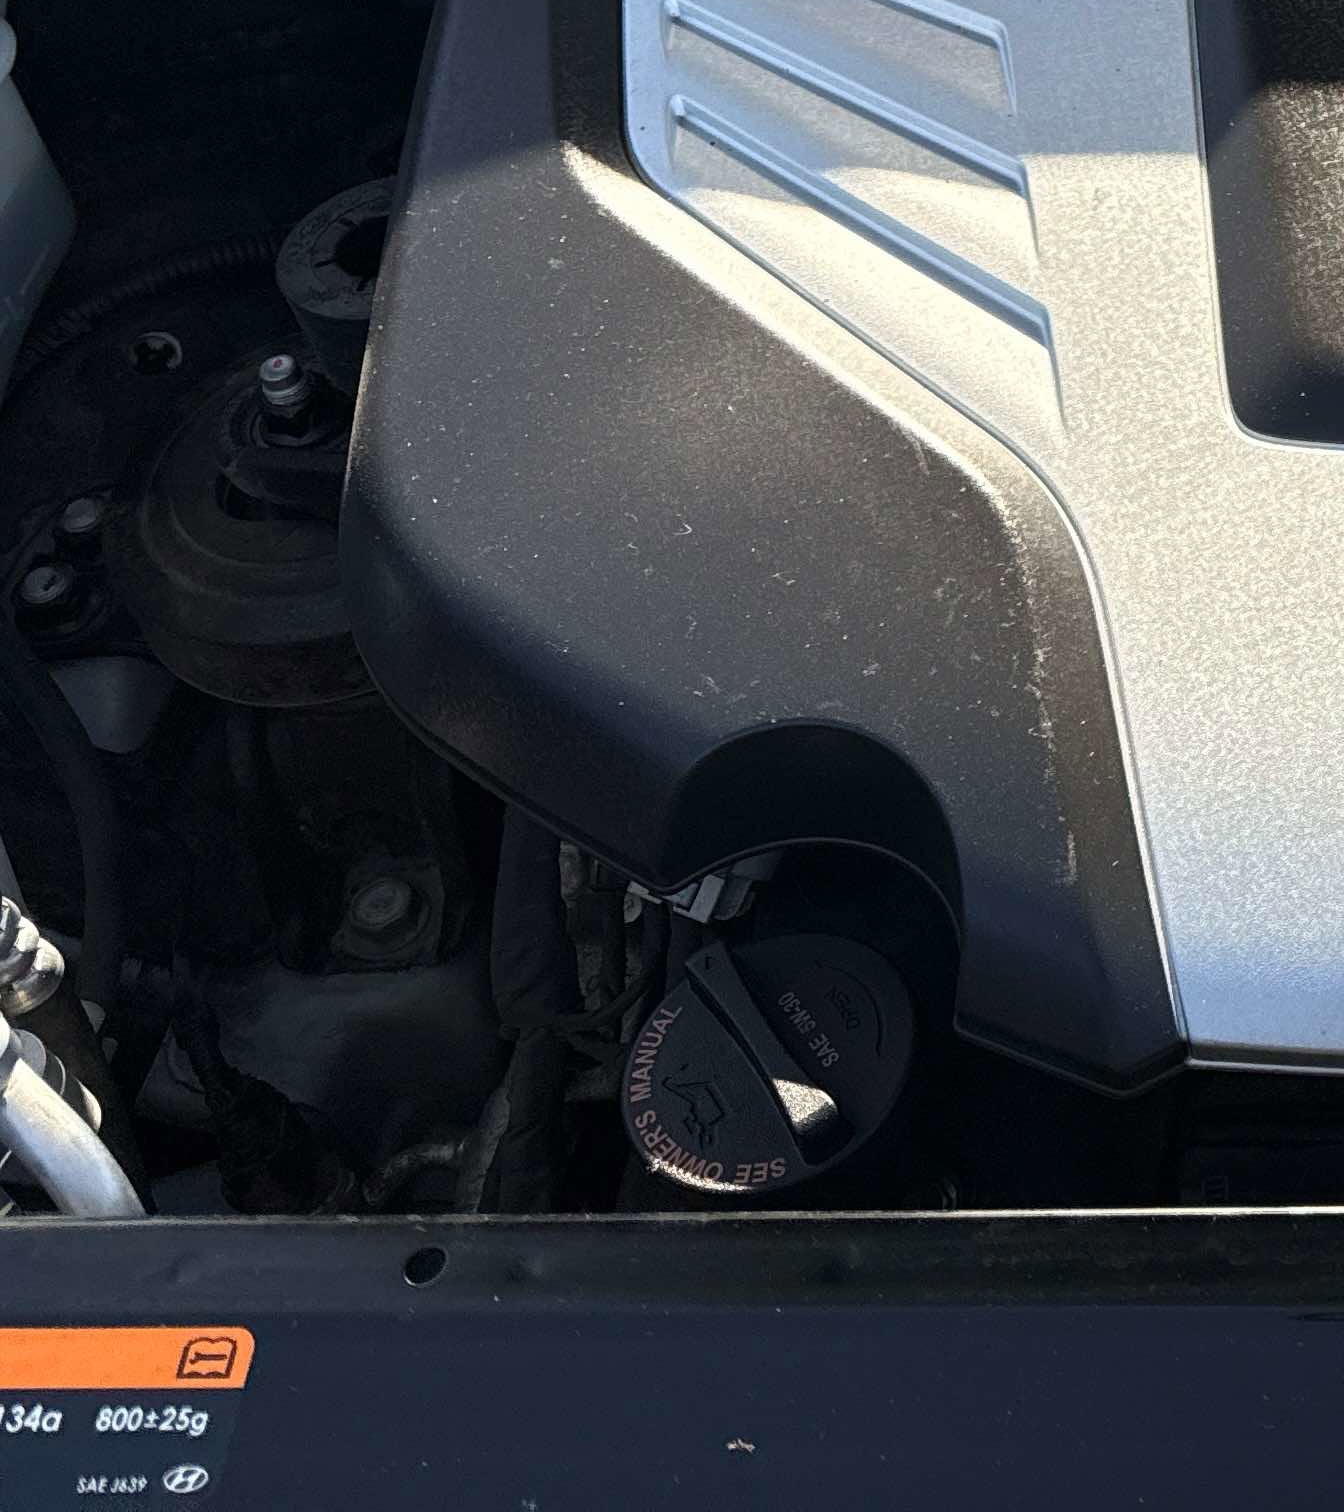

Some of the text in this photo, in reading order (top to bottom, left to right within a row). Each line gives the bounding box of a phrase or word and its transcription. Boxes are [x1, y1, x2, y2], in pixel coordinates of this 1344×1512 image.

[808, 1032, 840, 1068] SAE
[629, 1005, 787, 1184] SEE OWNER'S MANUAL
[76, 1475, 109, 1493] SAE
